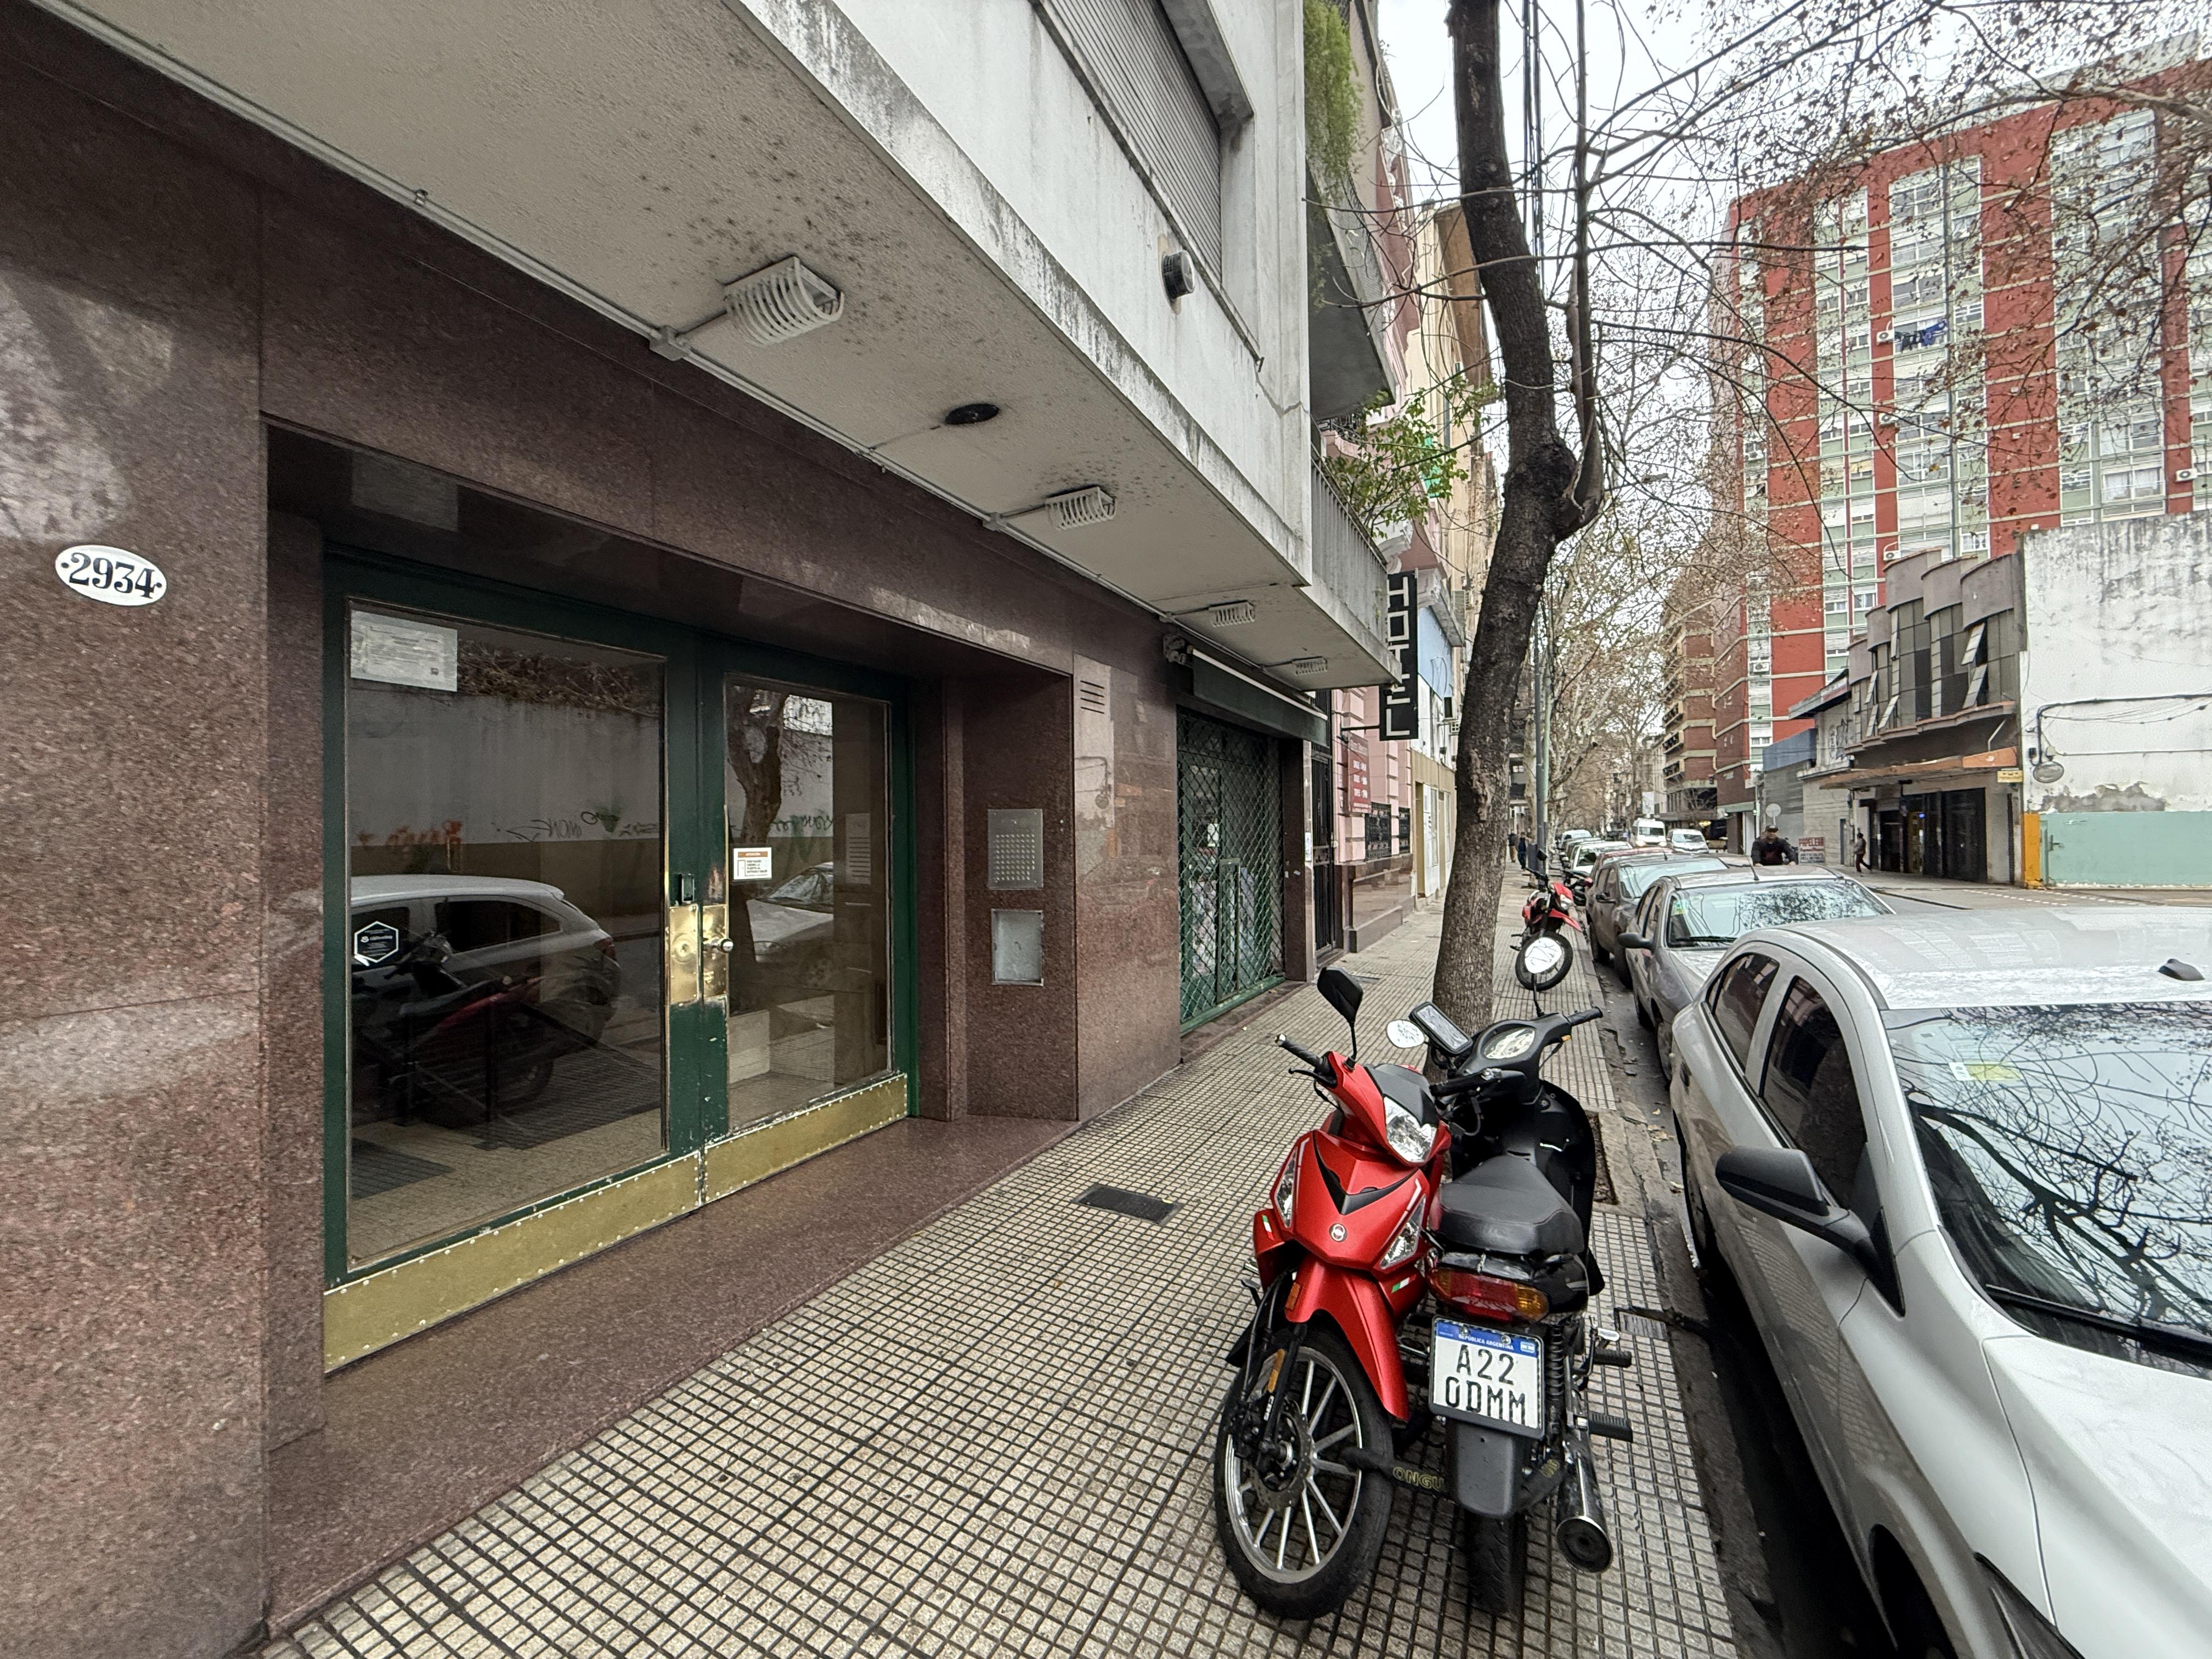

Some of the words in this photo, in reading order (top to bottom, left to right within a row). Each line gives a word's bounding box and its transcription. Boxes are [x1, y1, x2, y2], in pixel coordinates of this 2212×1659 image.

[69, 552, 155, 599] 2934
[1386, 576, 1410, 736] HOTEL
[1457, 1344, 1514, 1385] A22
